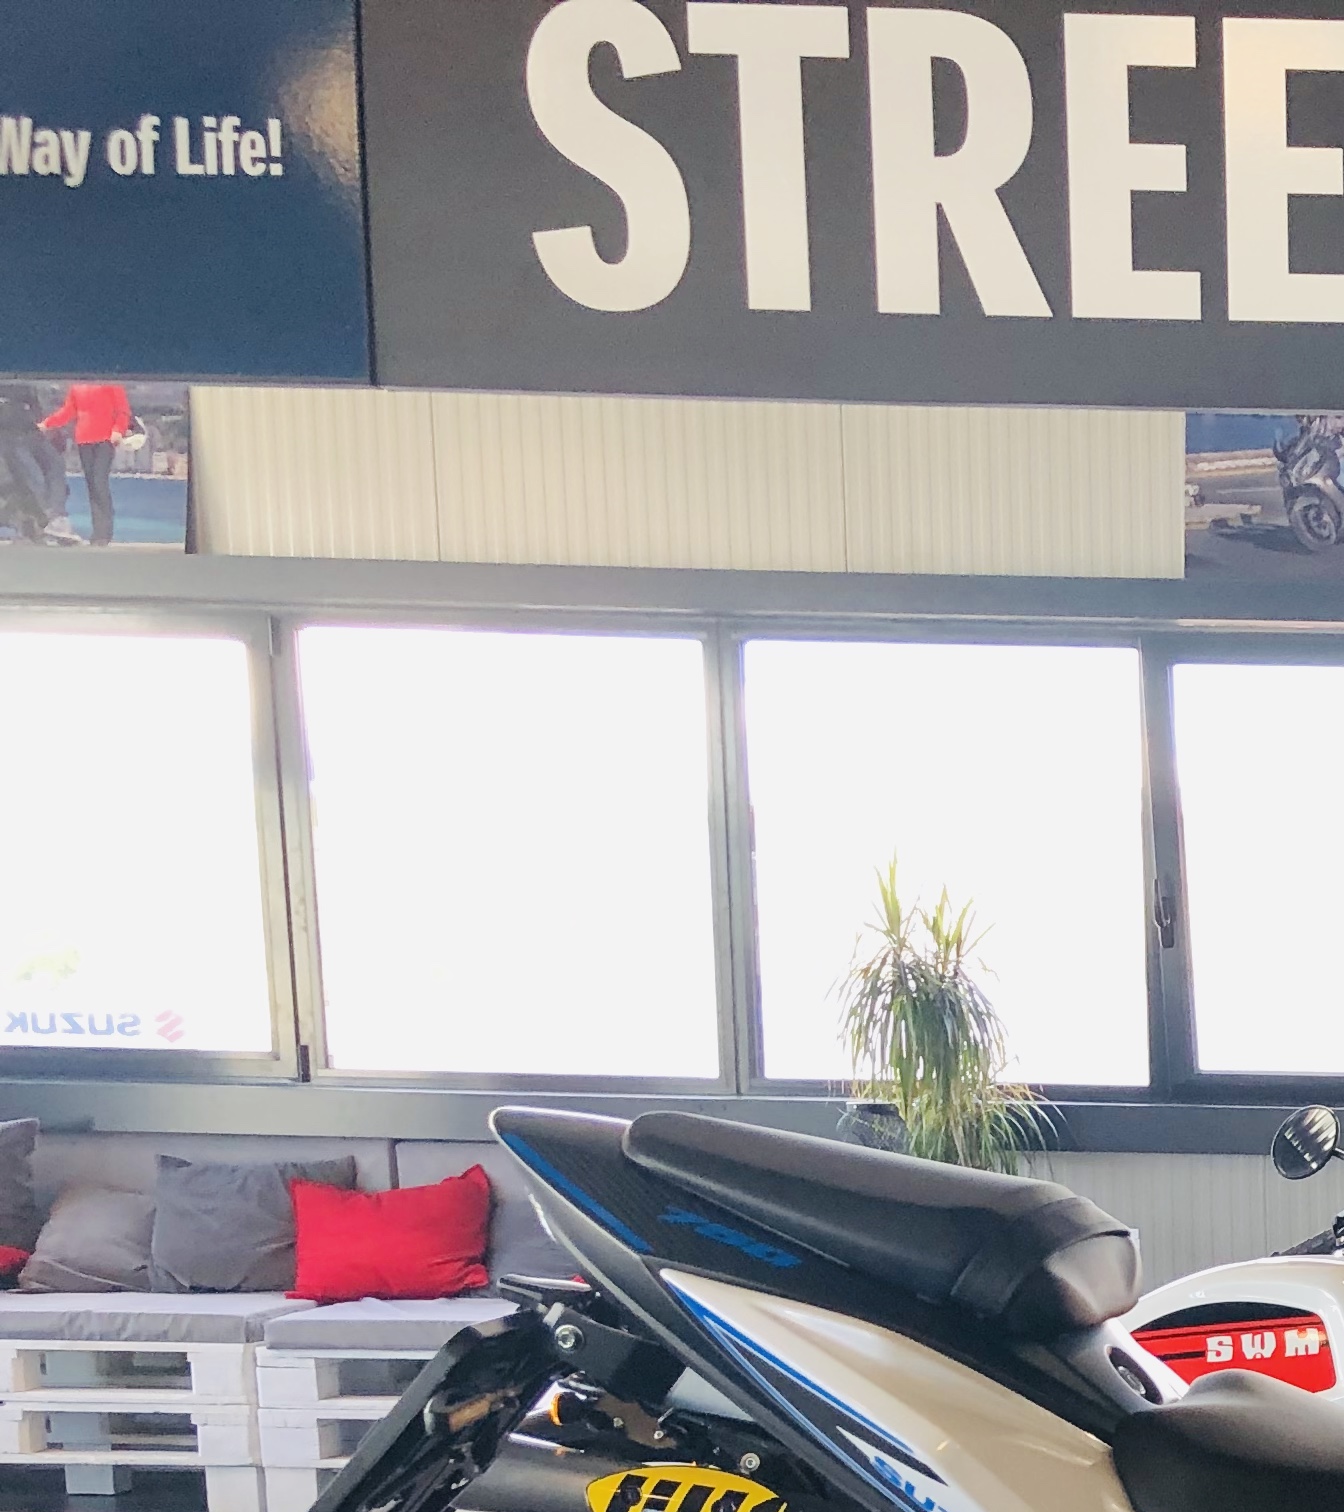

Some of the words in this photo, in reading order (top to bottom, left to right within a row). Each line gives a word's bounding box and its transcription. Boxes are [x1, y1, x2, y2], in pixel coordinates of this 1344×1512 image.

[0, 116, 91, 188] Way
[107, 114, 160, 176] of
[174, 115, 283, 176] Life!
[1206, 1327, 1320, 1363] SWM
